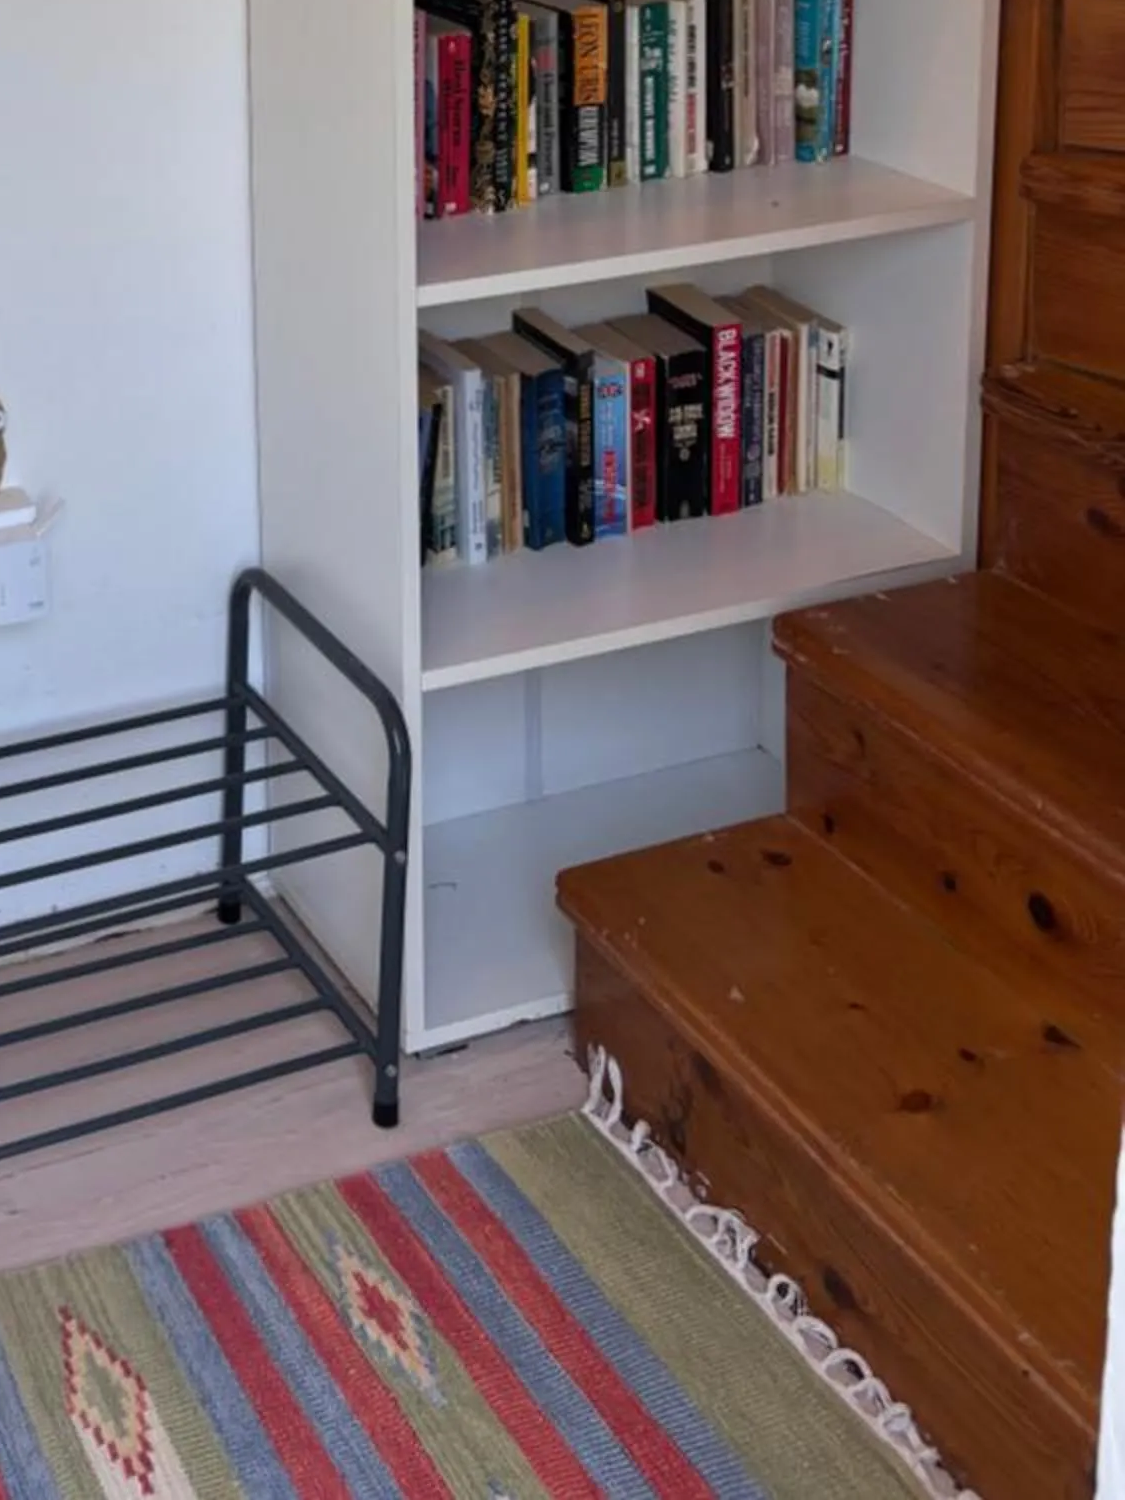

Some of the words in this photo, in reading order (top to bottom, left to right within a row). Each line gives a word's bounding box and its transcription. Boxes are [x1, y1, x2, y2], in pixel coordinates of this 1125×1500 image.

[577, 12, 601, 58] LEON
[716, 328, 737, 381] BLACK
[716, 382, 737, 438] WIDOW
